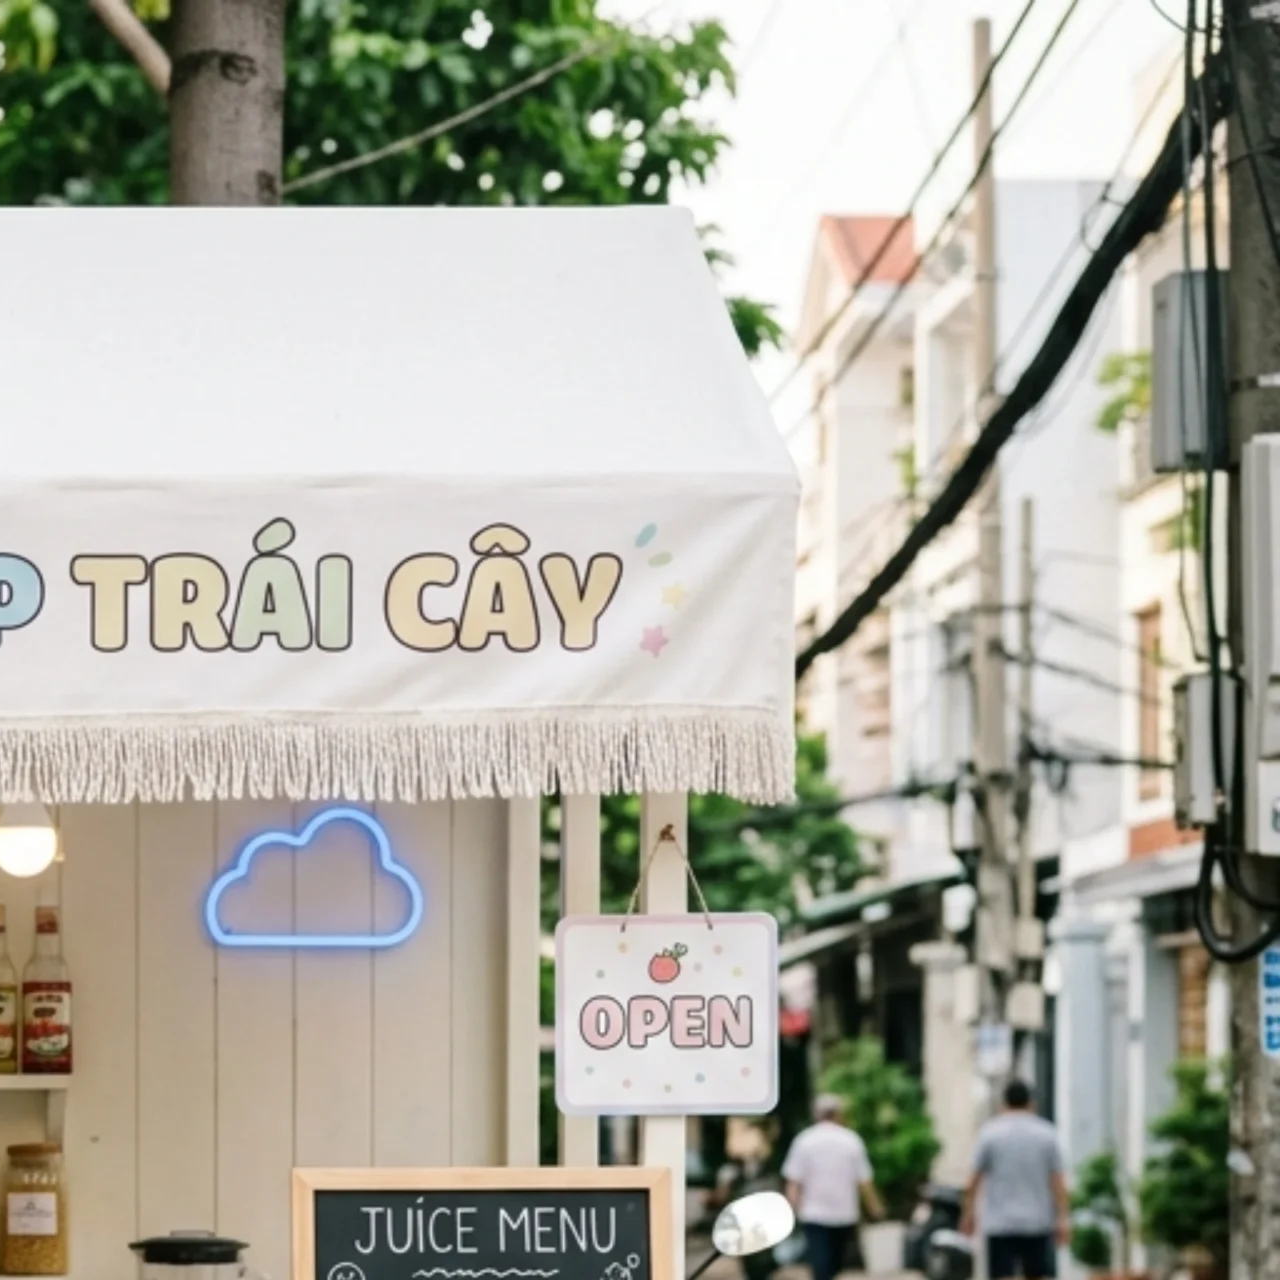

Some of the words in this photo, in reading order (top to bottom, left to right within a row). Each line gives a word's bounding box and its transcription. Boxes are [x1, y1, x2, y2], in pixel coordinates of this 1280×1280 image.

[70, 517, 352, 652] TRÁI
[384, 523, 622, 652] CÂY
[579, 994, 753, 1050] OPEN
[499, 1207, 616, 1254] MENU
